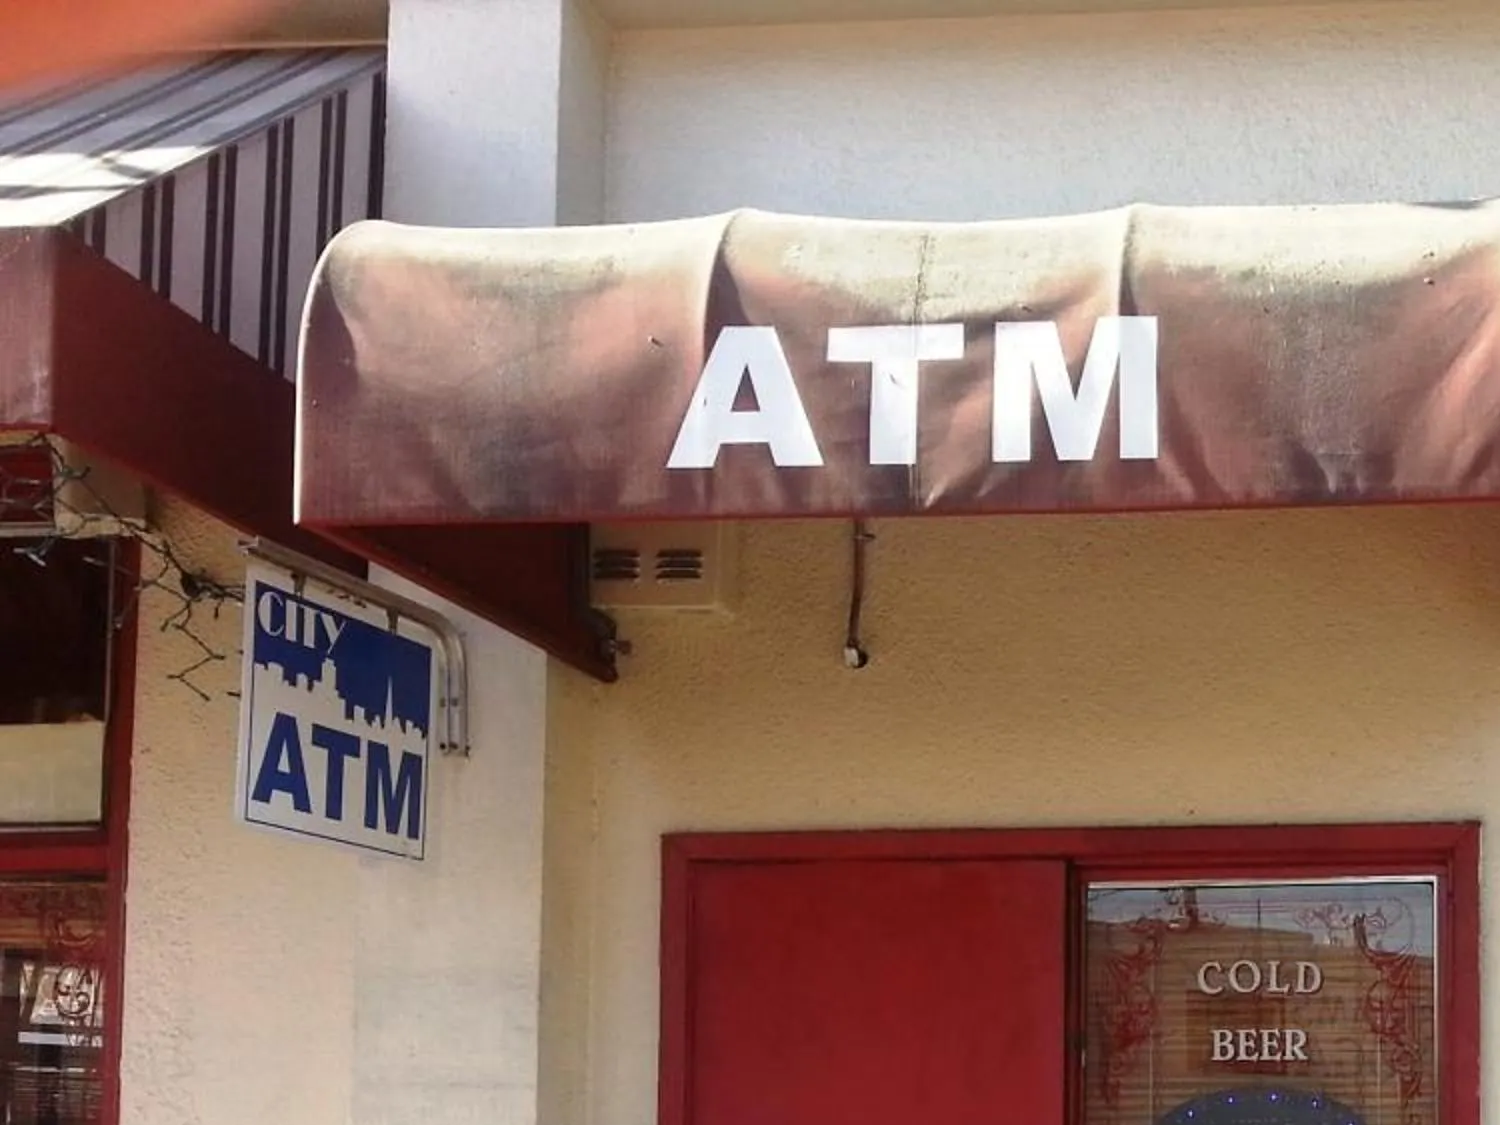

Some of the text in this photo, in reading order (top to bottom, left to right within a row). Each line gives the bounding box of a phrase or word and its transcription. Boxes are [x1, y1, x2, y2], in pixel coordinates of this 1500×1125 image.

[667, 315, 1158, 468] ATM
[257, 590, 347, 655] CITY
[251, 711, 422, 841] ATM
[1197, 960, 1324, 995] COLD
[1210, 1028, 1309, 1063] BEER
